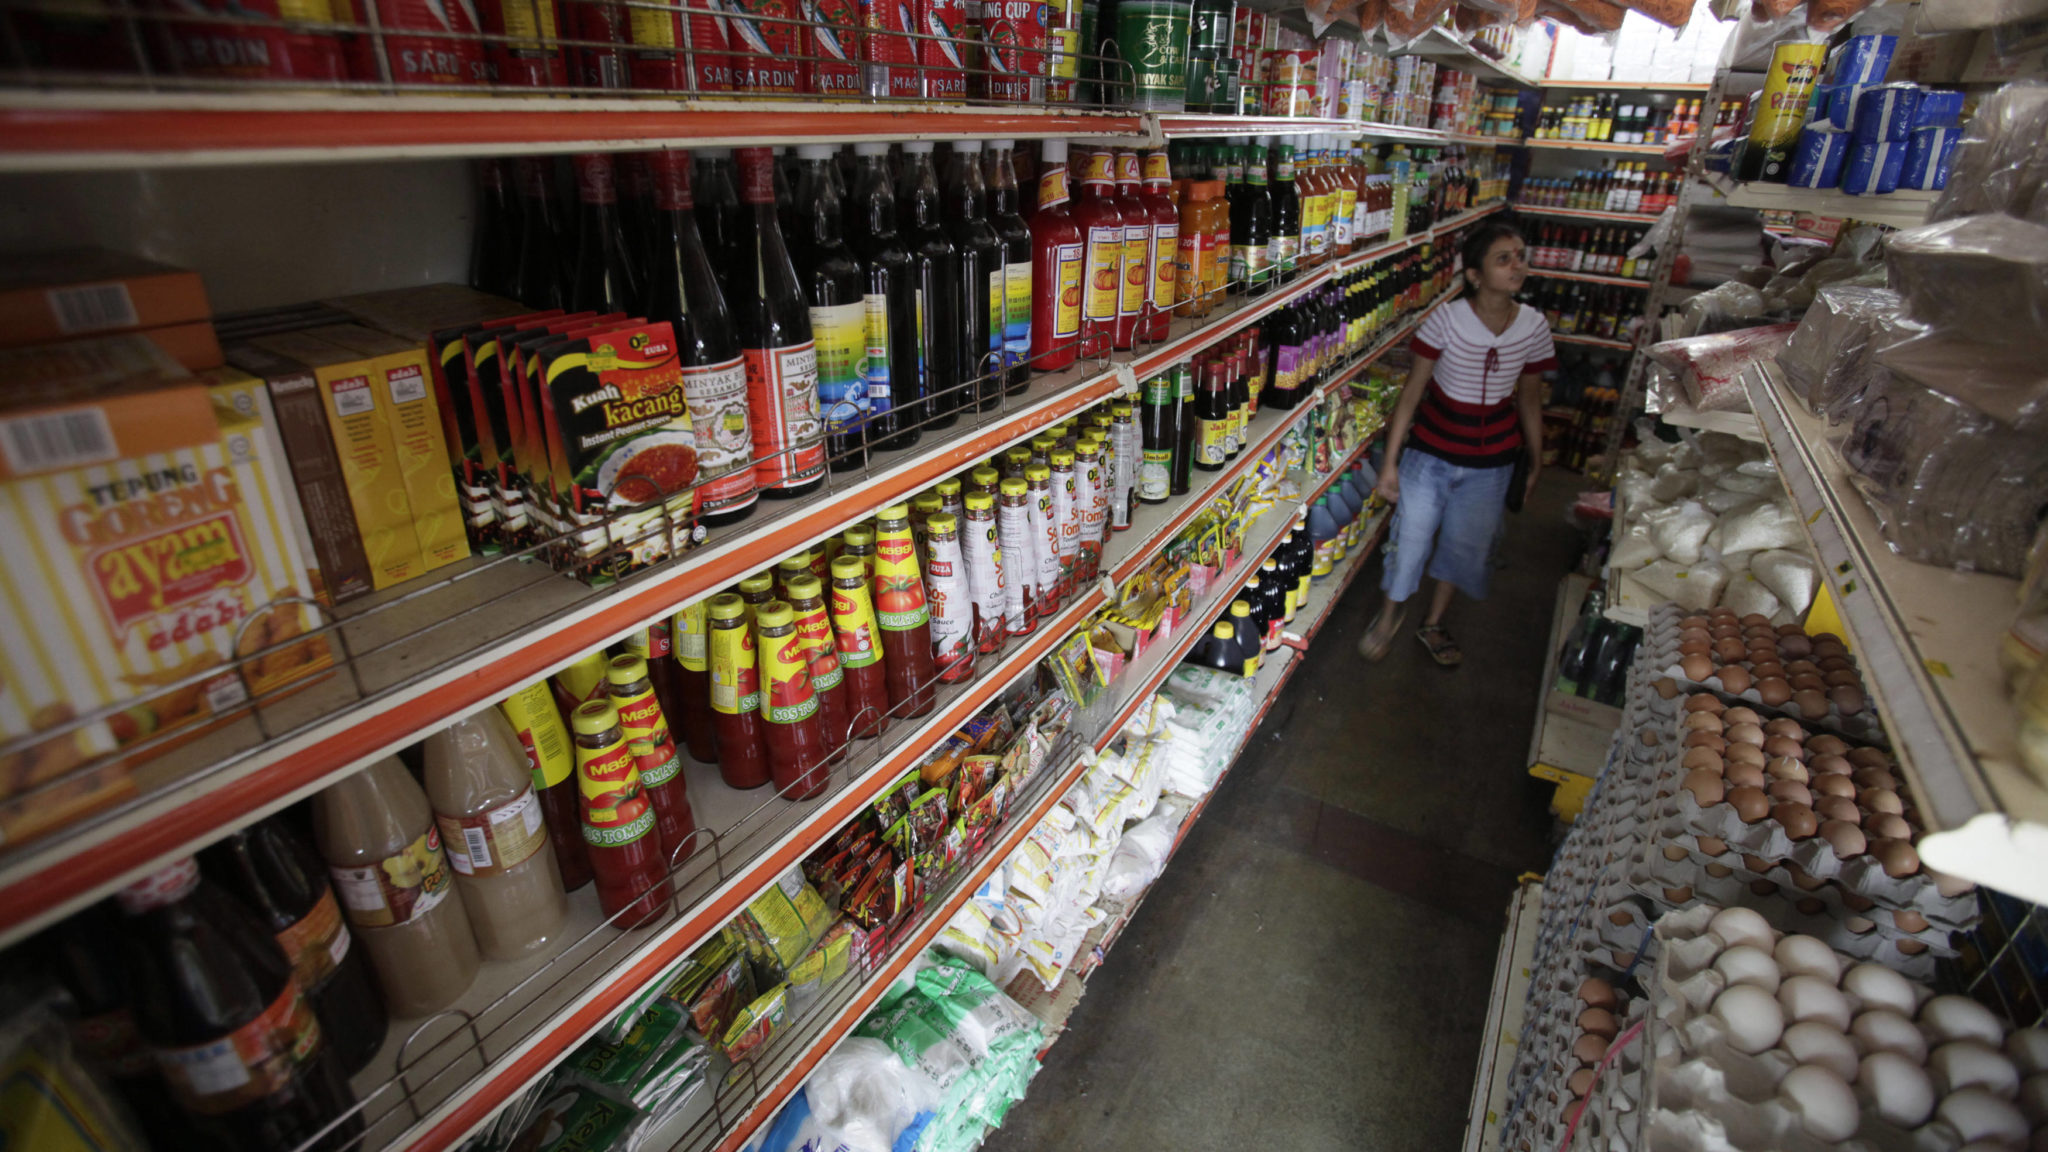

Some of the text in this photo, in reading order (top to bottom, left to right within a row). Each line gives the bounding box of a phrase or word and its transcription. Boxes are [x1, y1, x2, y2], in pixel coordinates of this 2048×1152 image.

[1005, 2, 1031, 19] CUP
[735, 69, 796, 87] SARDIN
[1128, 160, 1137, 174] A
[643, 344, 668, 355] ZUZA
[572, 383, 621, 414] Kuah
[603, 388, 684, 429] kacang
[581, 415, 671, 448] Instant Peanut Sauce
[88, 463, 198, 507] TEPUNG
[877, 543, 912, 556] Maggi
[102, 518, 241, 608] ayam
[930, 563, 952, 574] ZUZA
[146, 595, 248, 652] adabi
[879, 612, 922, 629] TOMATO
[774, 707, 798, 721] SOS
